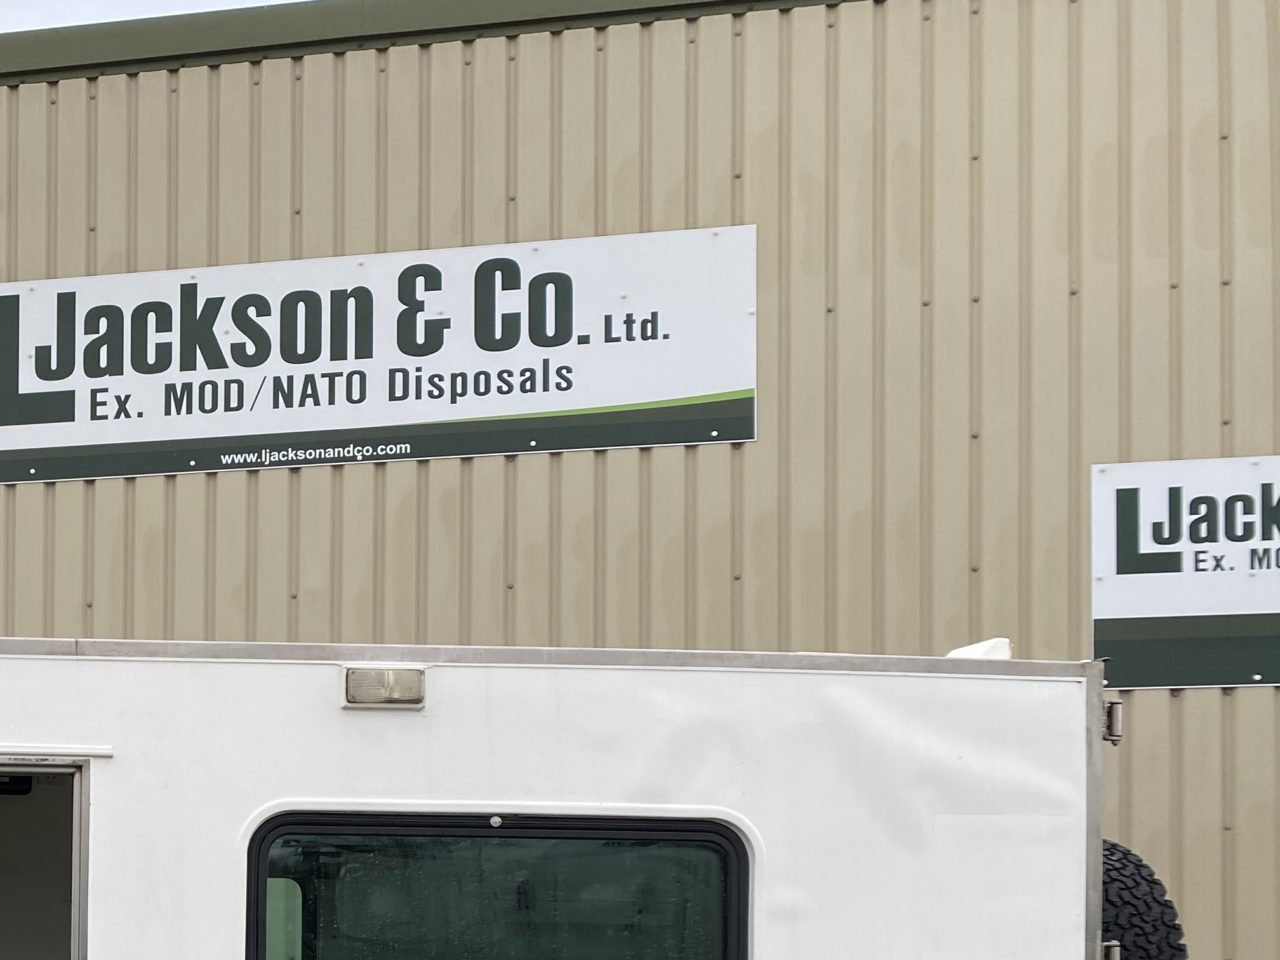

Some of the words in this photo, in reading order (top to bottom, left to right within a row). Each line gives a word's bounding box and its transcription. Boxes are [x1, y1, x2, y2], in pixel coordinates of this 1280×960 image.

[396, 263, 451, 358] &
[473, 257, 591, 353] Co.
[604, 311, 670, 344] Ltd.
[89, 387, 144, 421] Ex.
[164, 369, 367, 417] MOD/NATO
[388, 358, 574, 405] Disposals
[220, 443, 412, 465] www.ljacksonandco.com
[1194, 550, 1235, 573] Ex.
